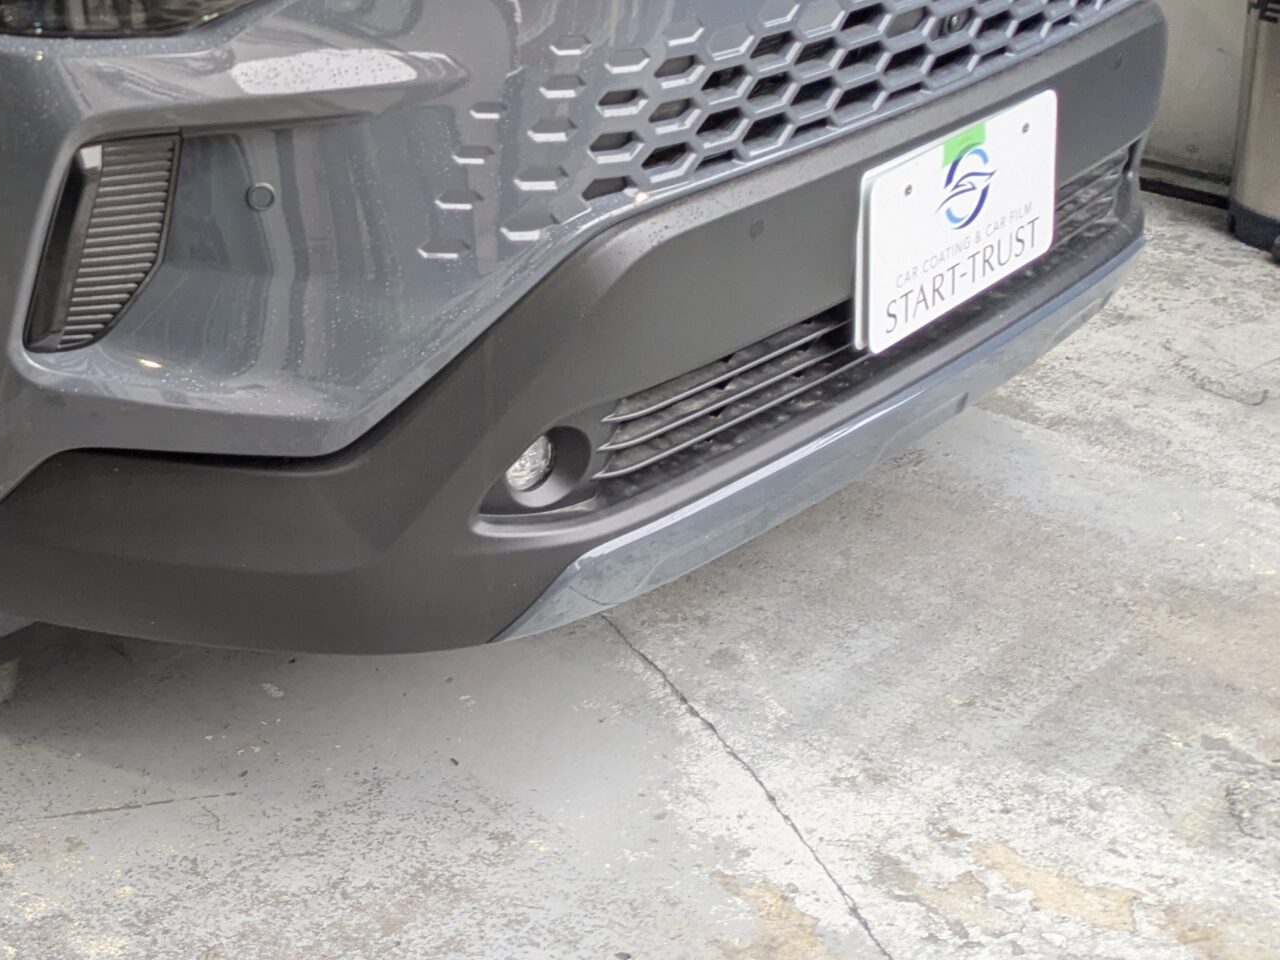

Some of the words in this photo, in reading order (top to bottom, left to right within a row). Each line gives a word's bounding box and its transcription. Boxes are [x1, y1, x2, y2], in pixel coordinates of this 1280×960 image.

[885, 216, 1040, 334] START-TRUST
[895, 265, 919, 288] CAR
[922, 236, 971, 273] COATING
[975, 230, 982, 244] &
[985, 216, 1006, 237] CAR
[1009, 201, 1032, 224] FILM
